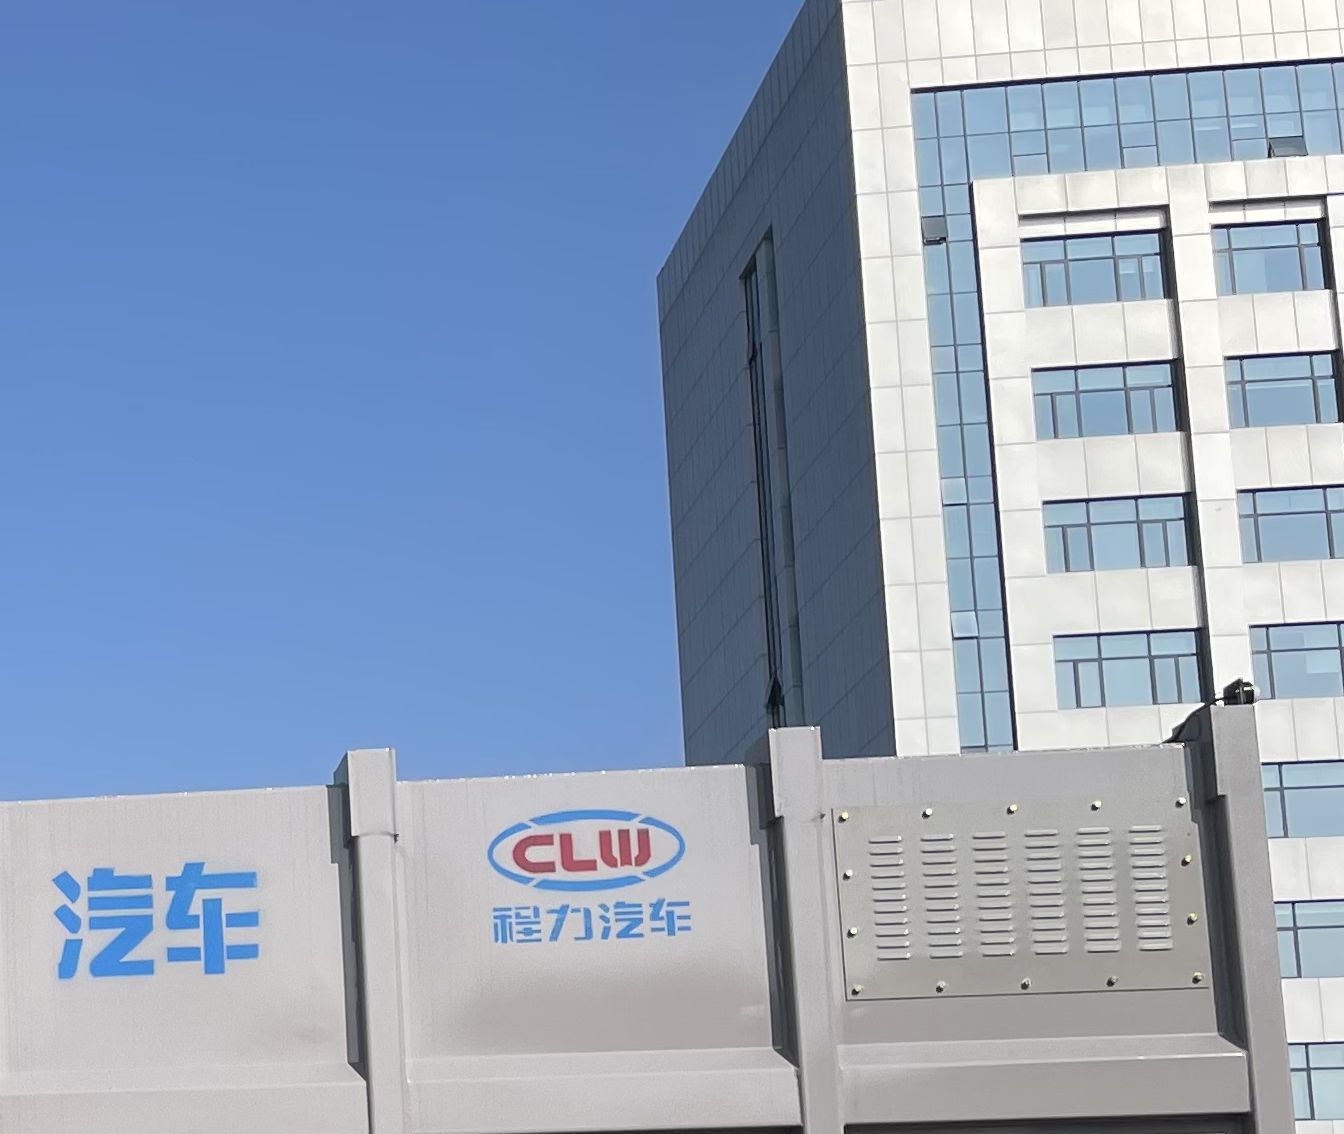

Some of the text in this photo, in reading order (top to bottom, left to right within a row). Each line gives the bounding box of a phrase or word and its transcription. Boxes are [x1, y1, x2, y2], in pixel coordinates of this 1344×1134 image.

[512, 828, 652, 873] CLW
[53, 862, 259, 980] 汽车
[492, 898, 691, 944] 程力汽车
